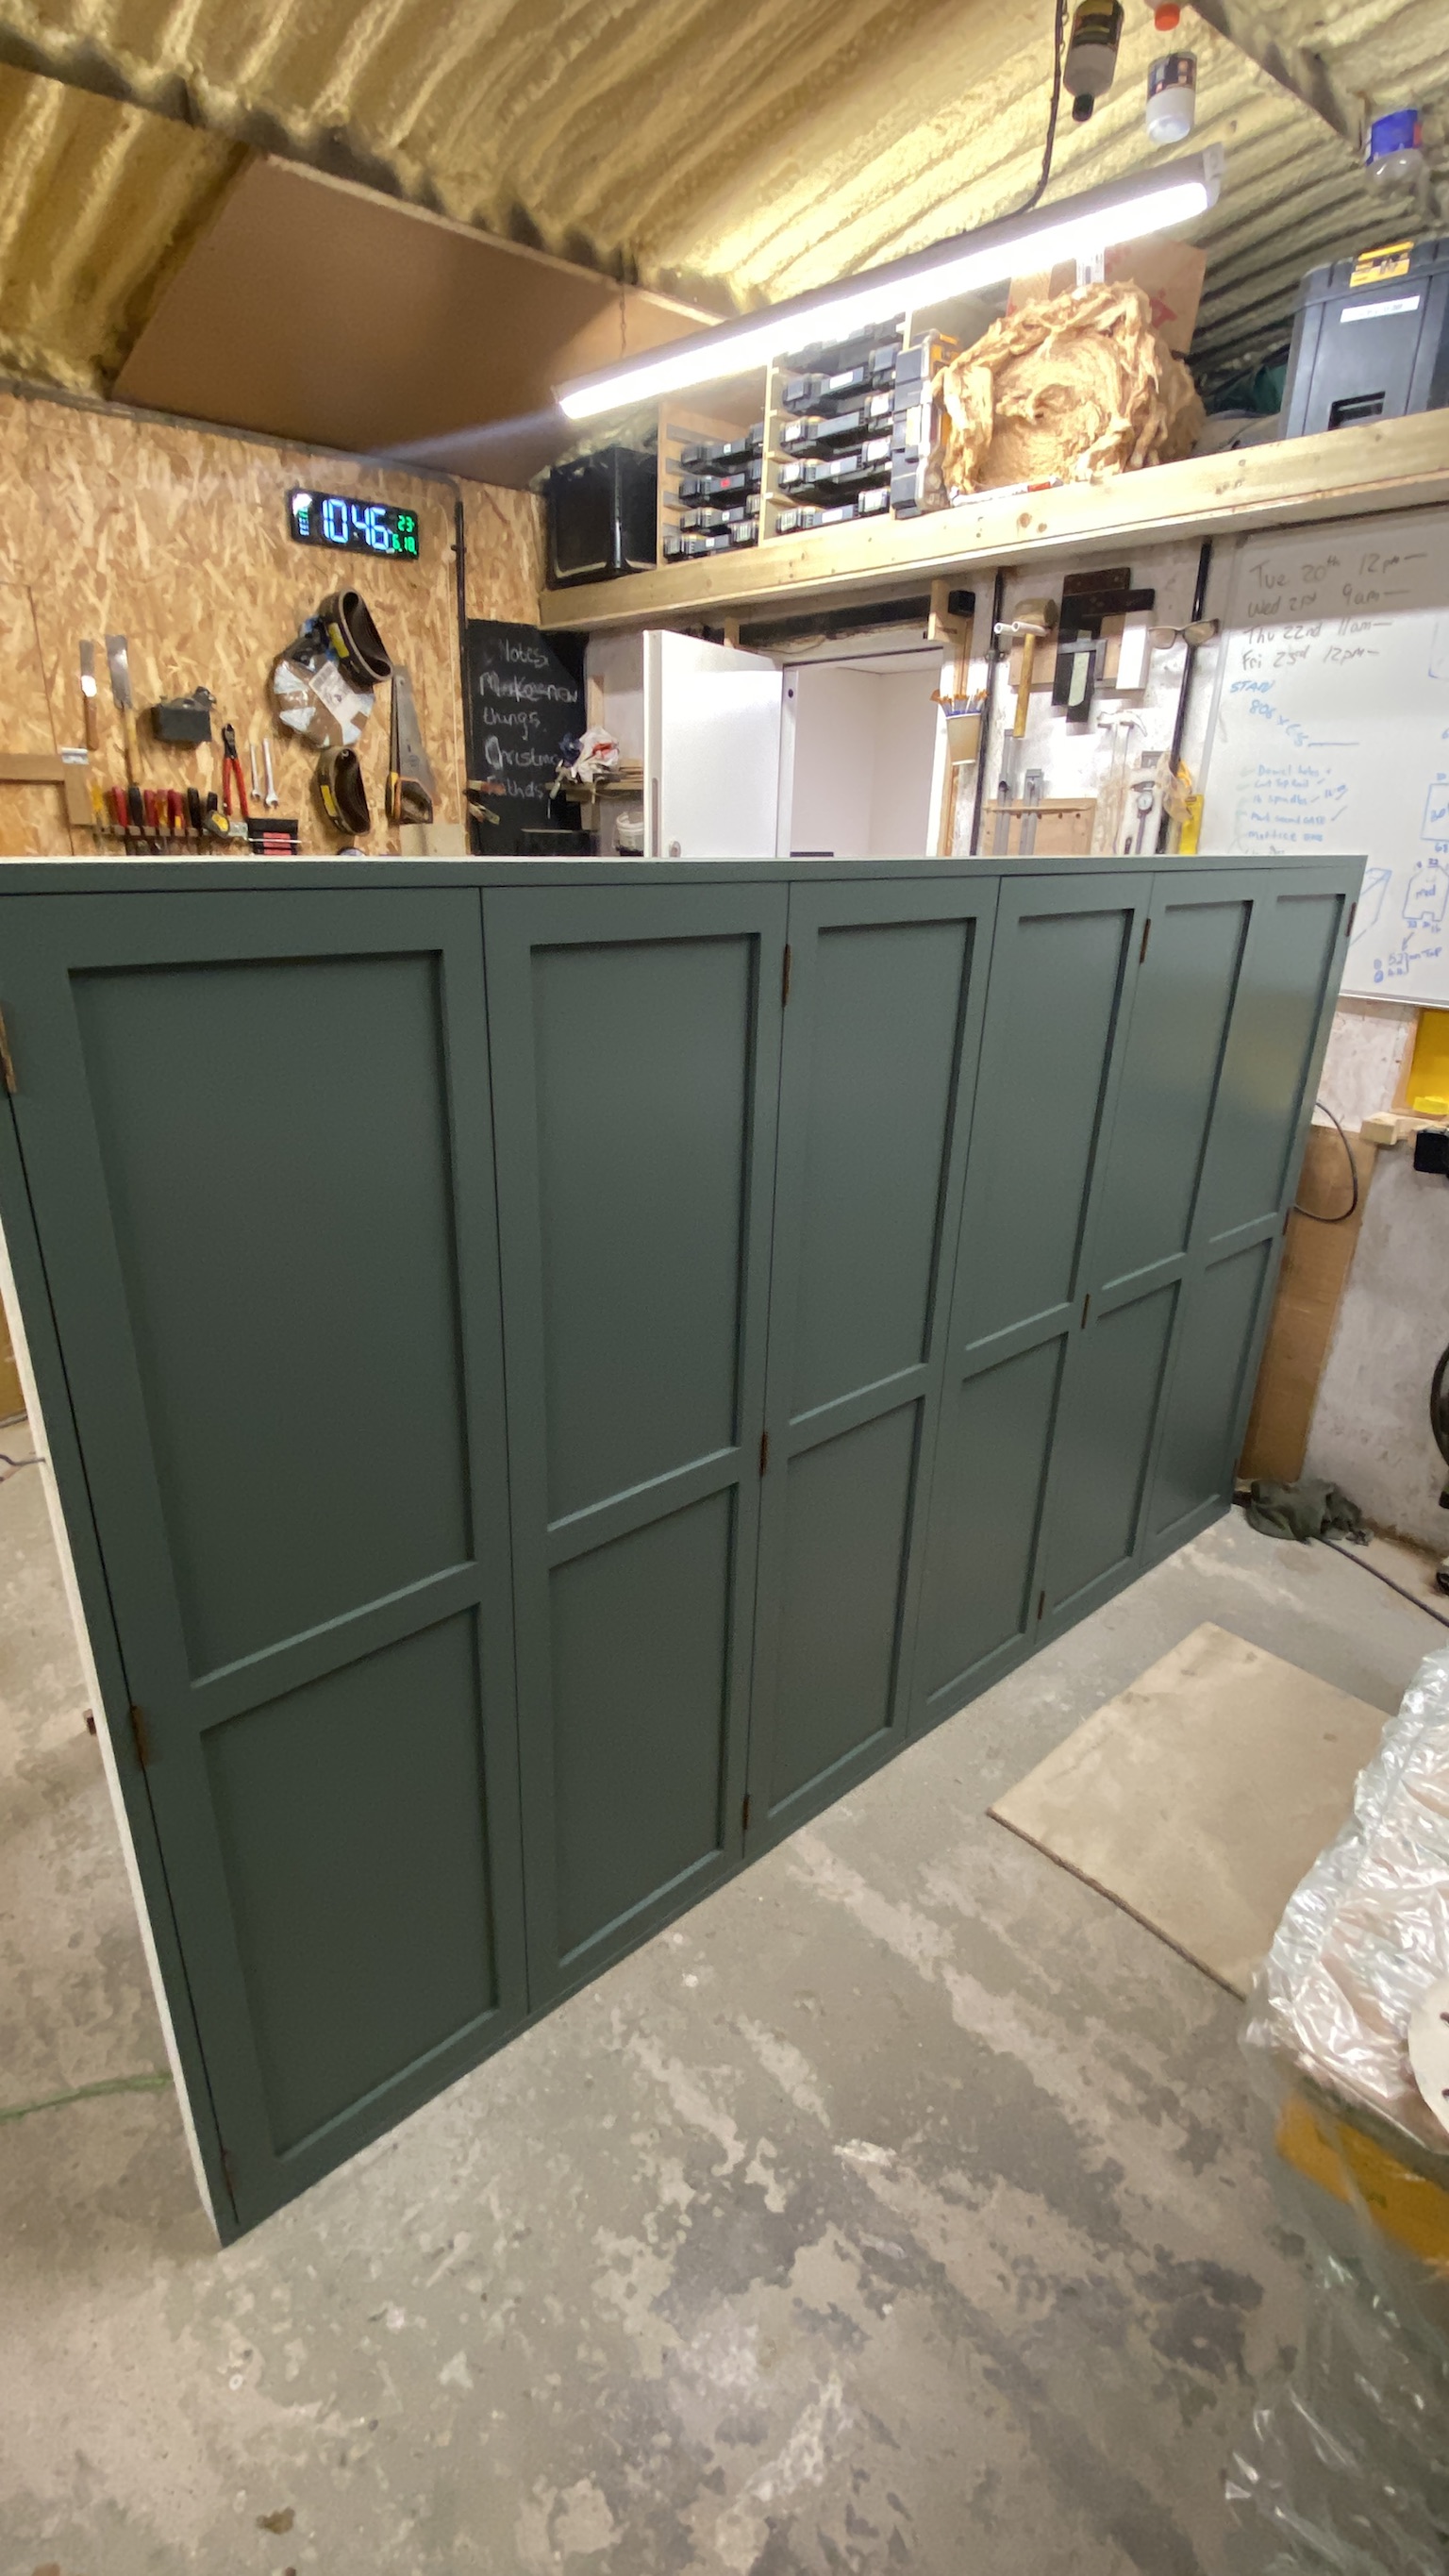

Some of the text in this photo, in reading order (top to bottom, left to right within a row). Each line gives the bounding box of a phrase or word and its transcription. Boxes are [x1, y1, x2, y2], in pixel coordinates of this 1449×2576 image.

[1250, 559, 1288, 589] Tue
[1248, 595, 1281, 618] Wed
[1342, 583, 1380, 606] 9am
[1243, 627, 1274, 644] Thu
[1283, 622, 1323, 640] 22nd
[1242, 649, 1263, 671] Fri
